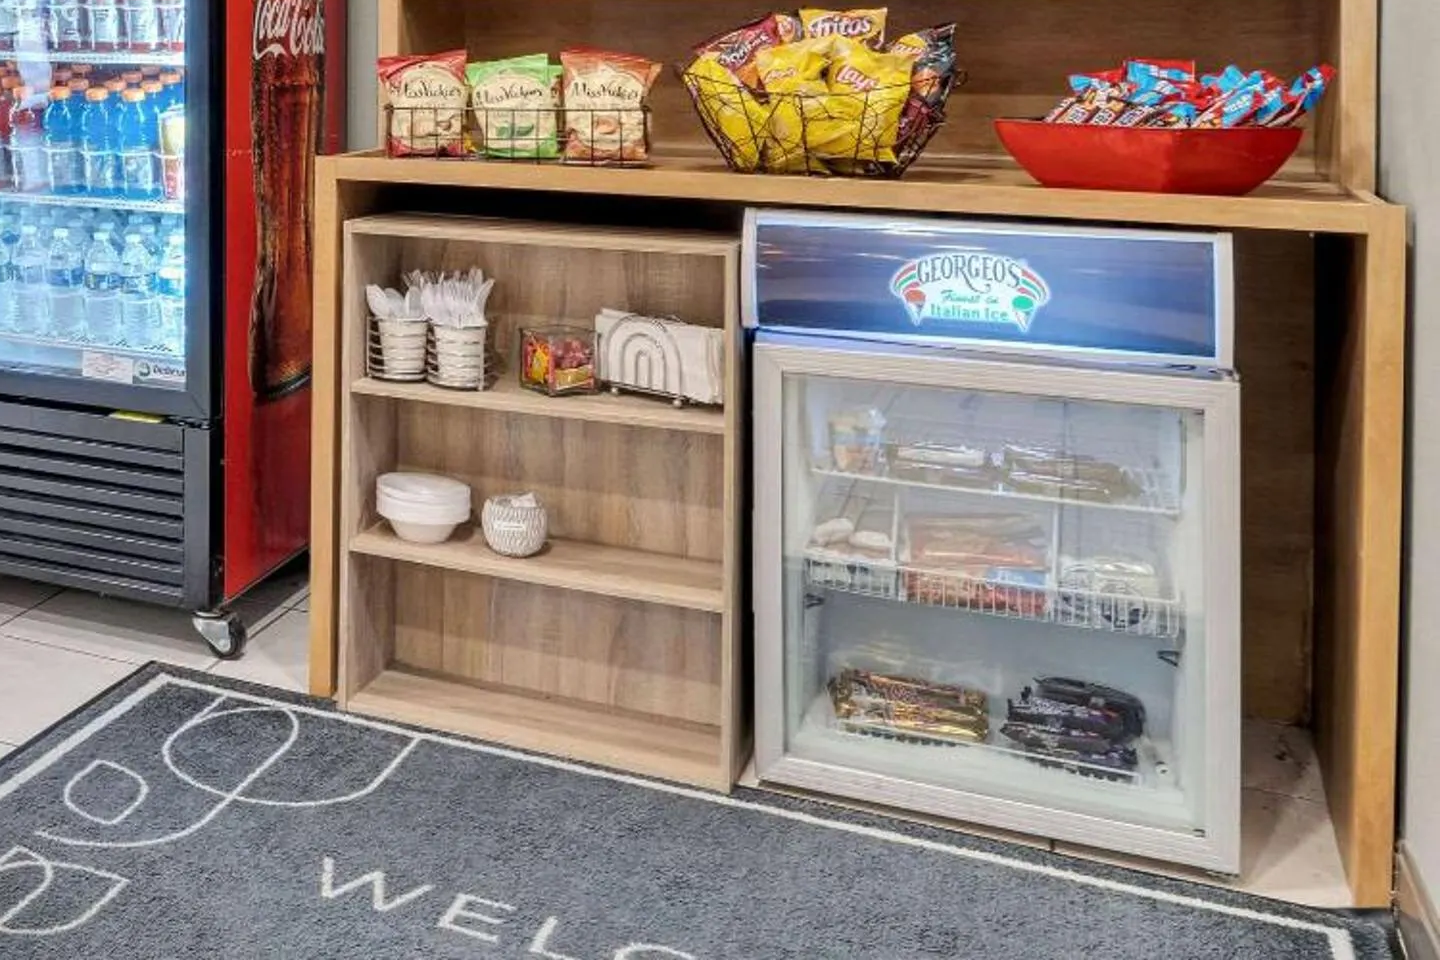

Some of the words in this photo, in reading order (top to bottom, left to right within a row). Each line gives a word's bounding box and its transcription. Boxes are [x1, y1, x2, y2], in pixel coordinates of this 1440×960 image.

[917, 254, 1021, 294] GEORGEO'S
[930, 303, 981, 319] Italian
[984, 307, 1010, 321] Ice
